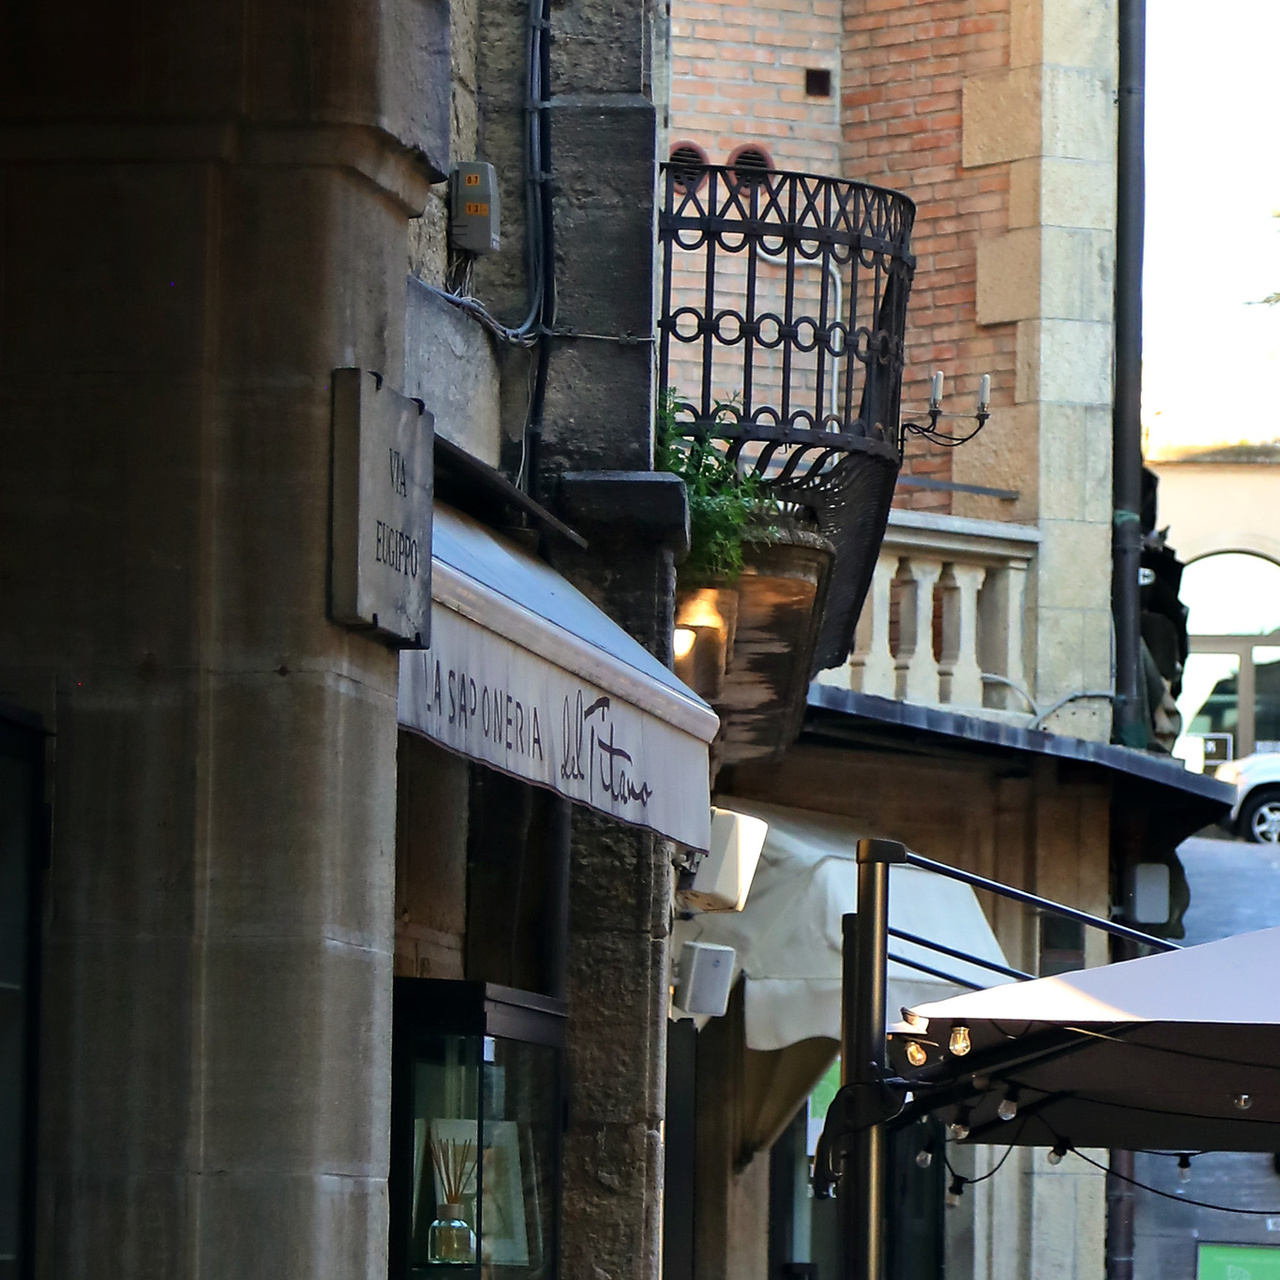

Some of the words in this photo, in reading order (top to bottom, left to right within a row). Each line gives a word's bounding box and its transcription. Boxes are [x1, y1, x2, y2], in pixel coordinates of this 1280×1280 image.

[389, 448, 407, 498] VIA
[376, 520, 418, 577] EUGIPPO
[448, 669, 543, 761] SAPONERIA
